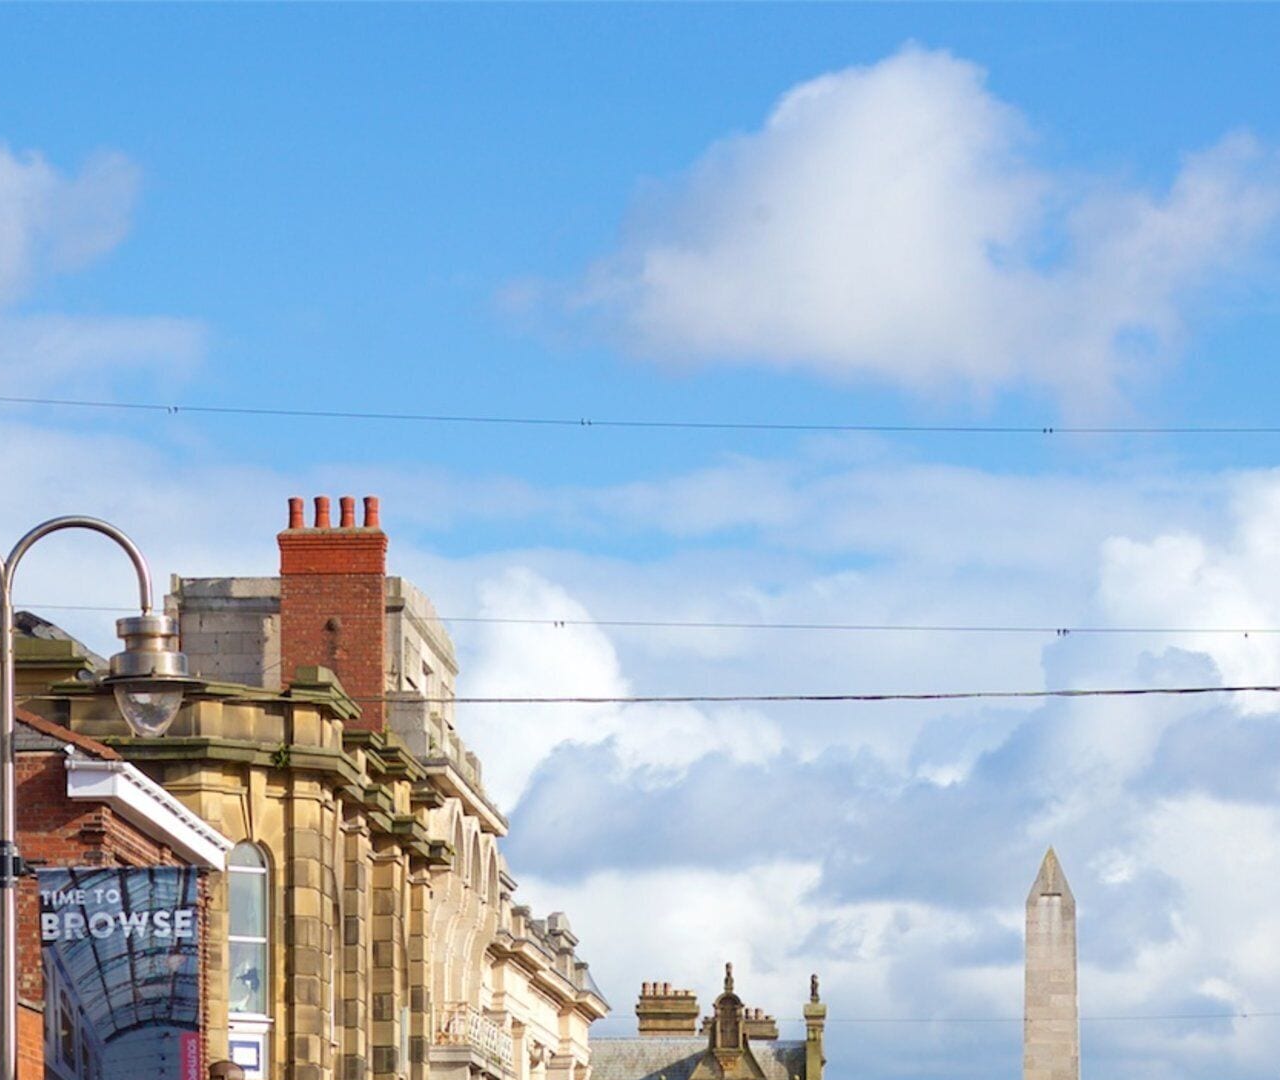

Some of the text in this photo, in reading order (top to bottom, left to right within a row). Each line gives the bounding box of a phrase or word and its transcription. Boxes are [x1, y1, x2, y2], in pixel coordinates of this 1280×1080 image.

[41, 889, 119, 906] TIME TO
[41, 910, 193, 941] BROWSE
